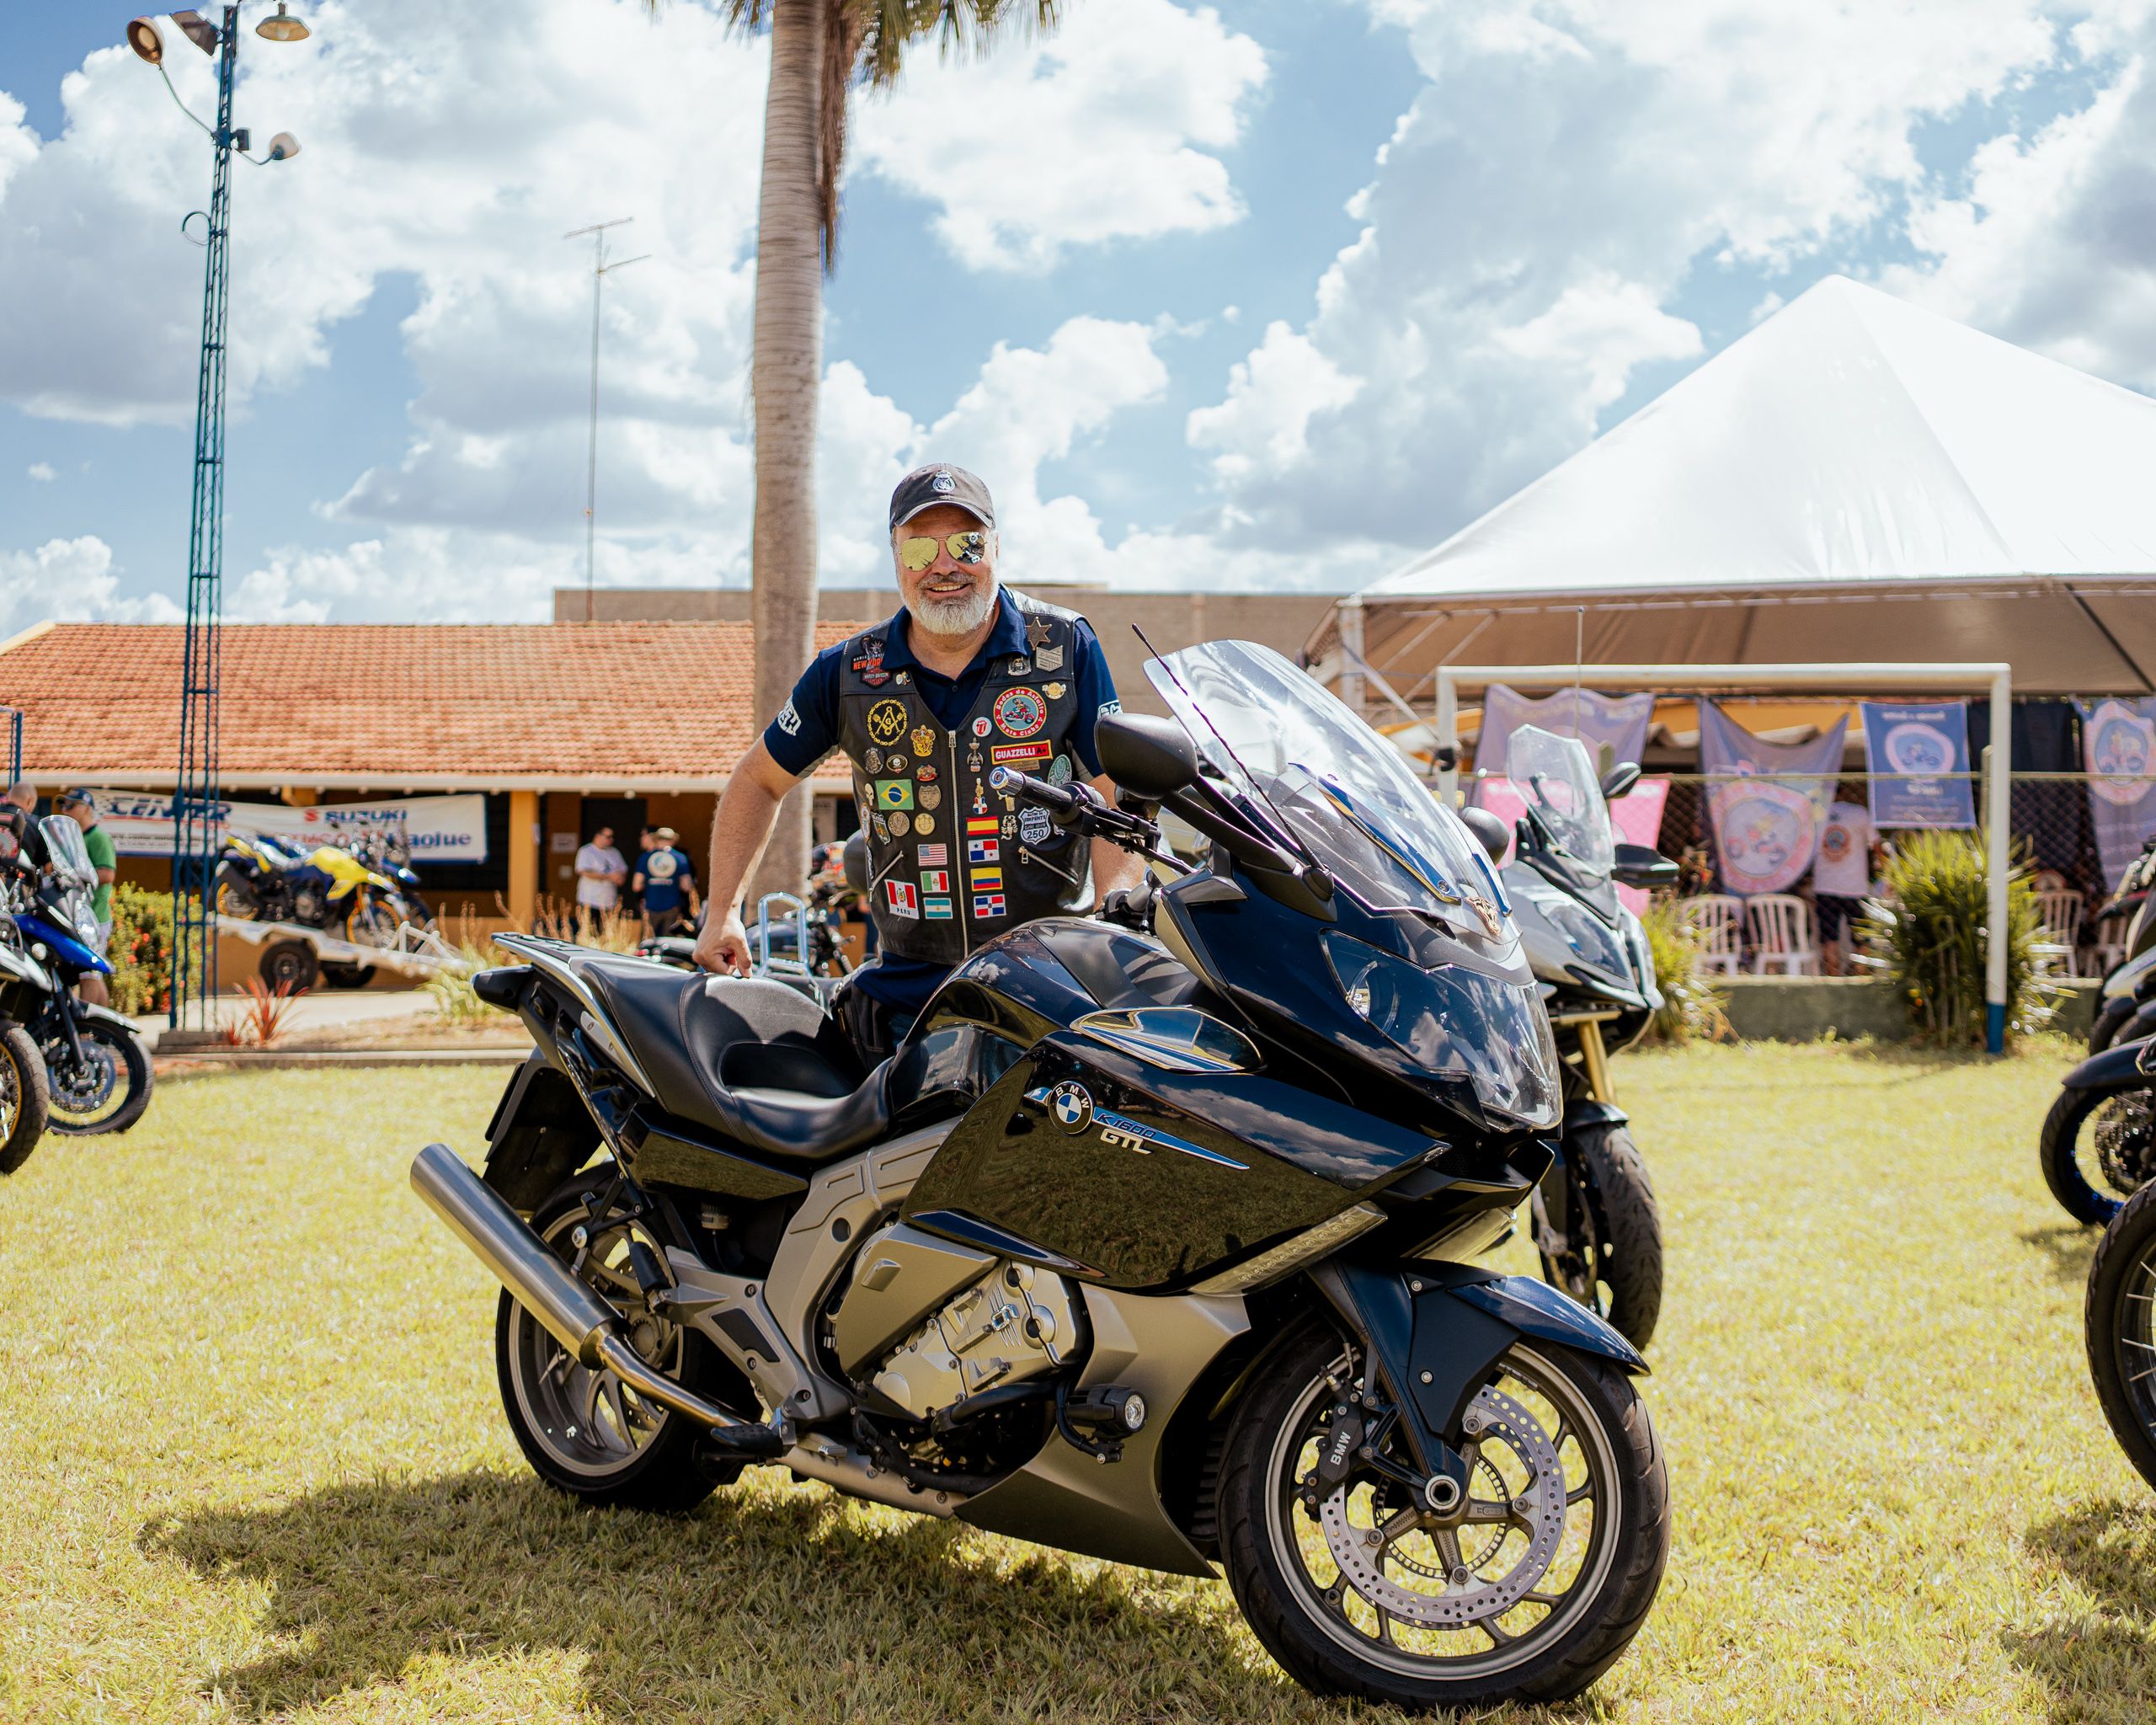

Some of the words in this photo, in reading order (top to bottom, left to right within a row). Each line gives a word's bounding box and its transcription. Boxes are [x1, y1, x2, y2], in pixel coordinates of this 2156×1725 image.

[853, 660, 867, 670] NEW
[995, 747, 1036, 760] GUAZZELLI
[325, 809, 408, 823] SUZUKI
[1027, 829, 1044, 840] 250
[1055, 1085, 1090, 1108] BMW
[1100, 1129, 1153, 1155] GTL
[1330, 1431, 1351, 1466] BMW
